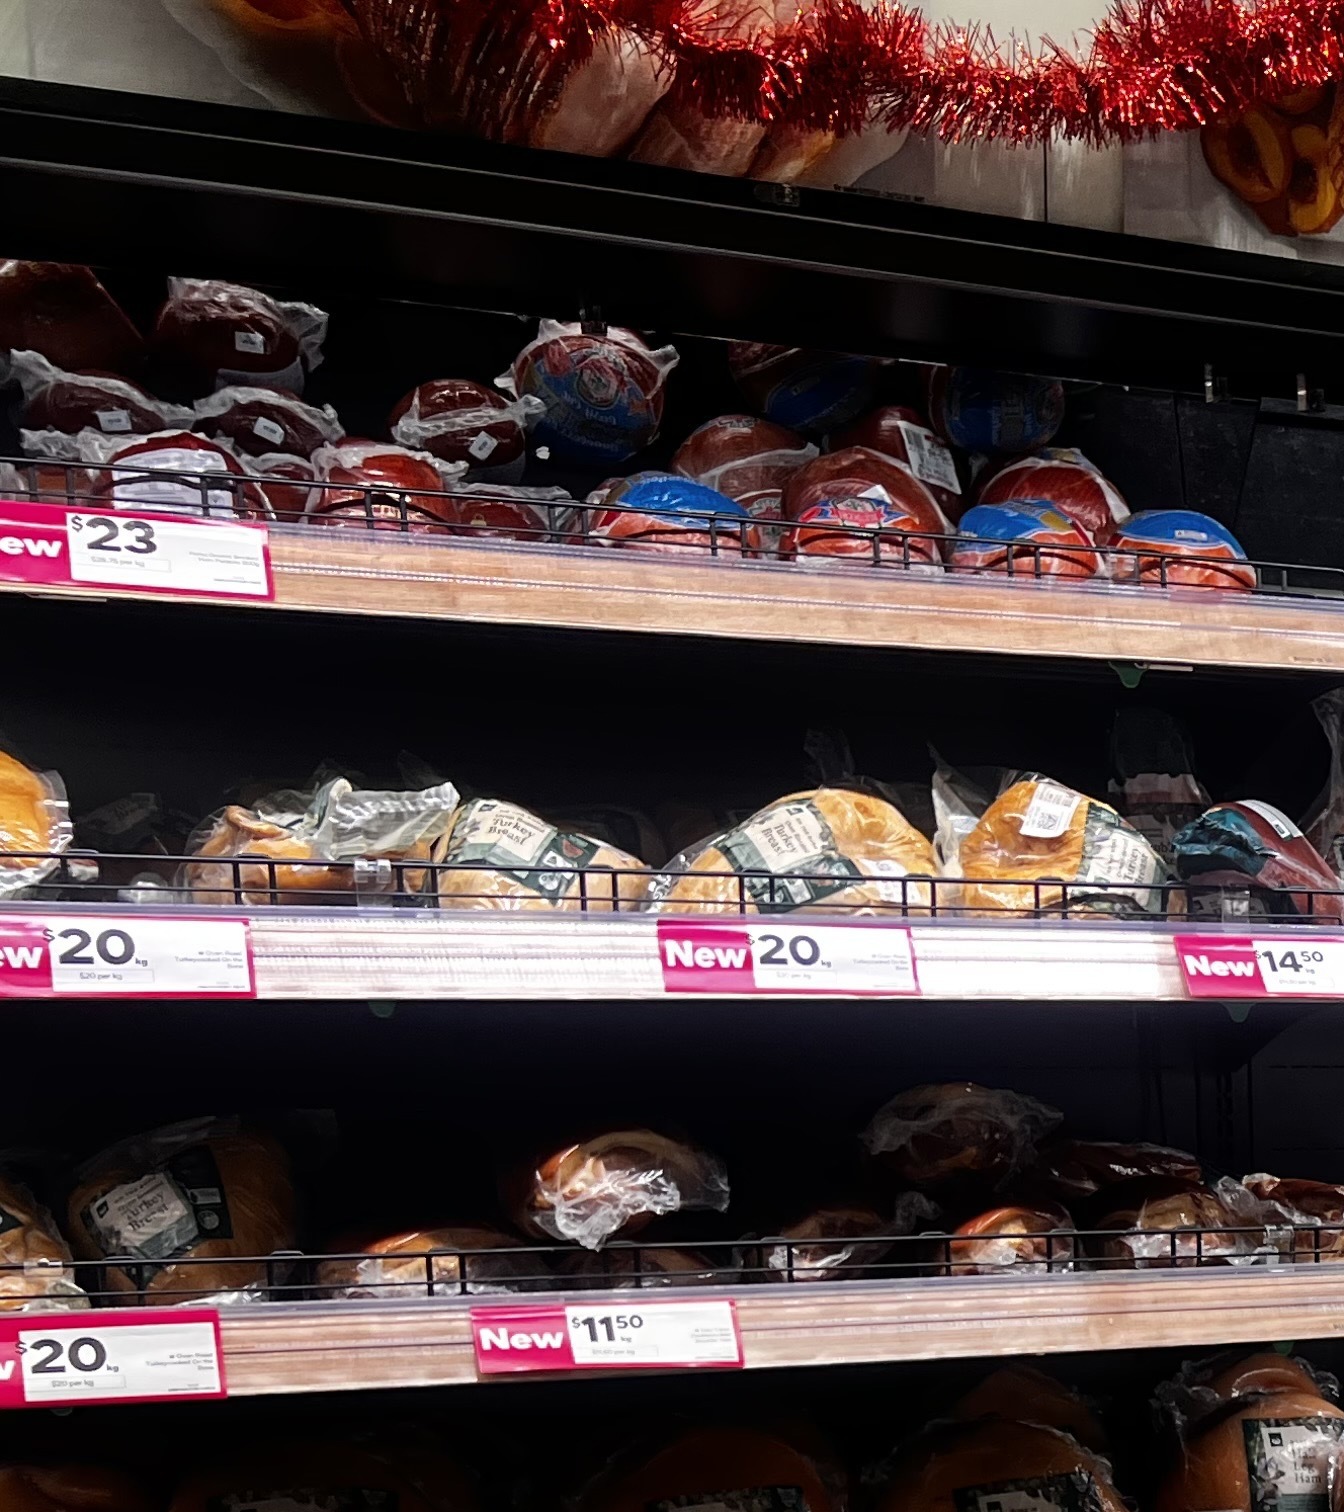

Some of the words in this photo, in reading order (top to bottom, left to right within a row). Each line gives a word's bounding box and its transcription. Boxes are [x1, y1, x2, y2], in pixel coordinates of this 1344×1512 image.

[71, 516, 157, 554] $23
[494, 817, 535, 843] Turkey
[43, 928, 135, 965] $20
[664, 939, 747, 968] New
[746, 933, 820, 966] $20
[1183, 955, 1254, 977] New
[479, 1327, 563, 1350] New
[16, 1336, 107, 1374] $20
[107, 1364, 119, 1373] kg
